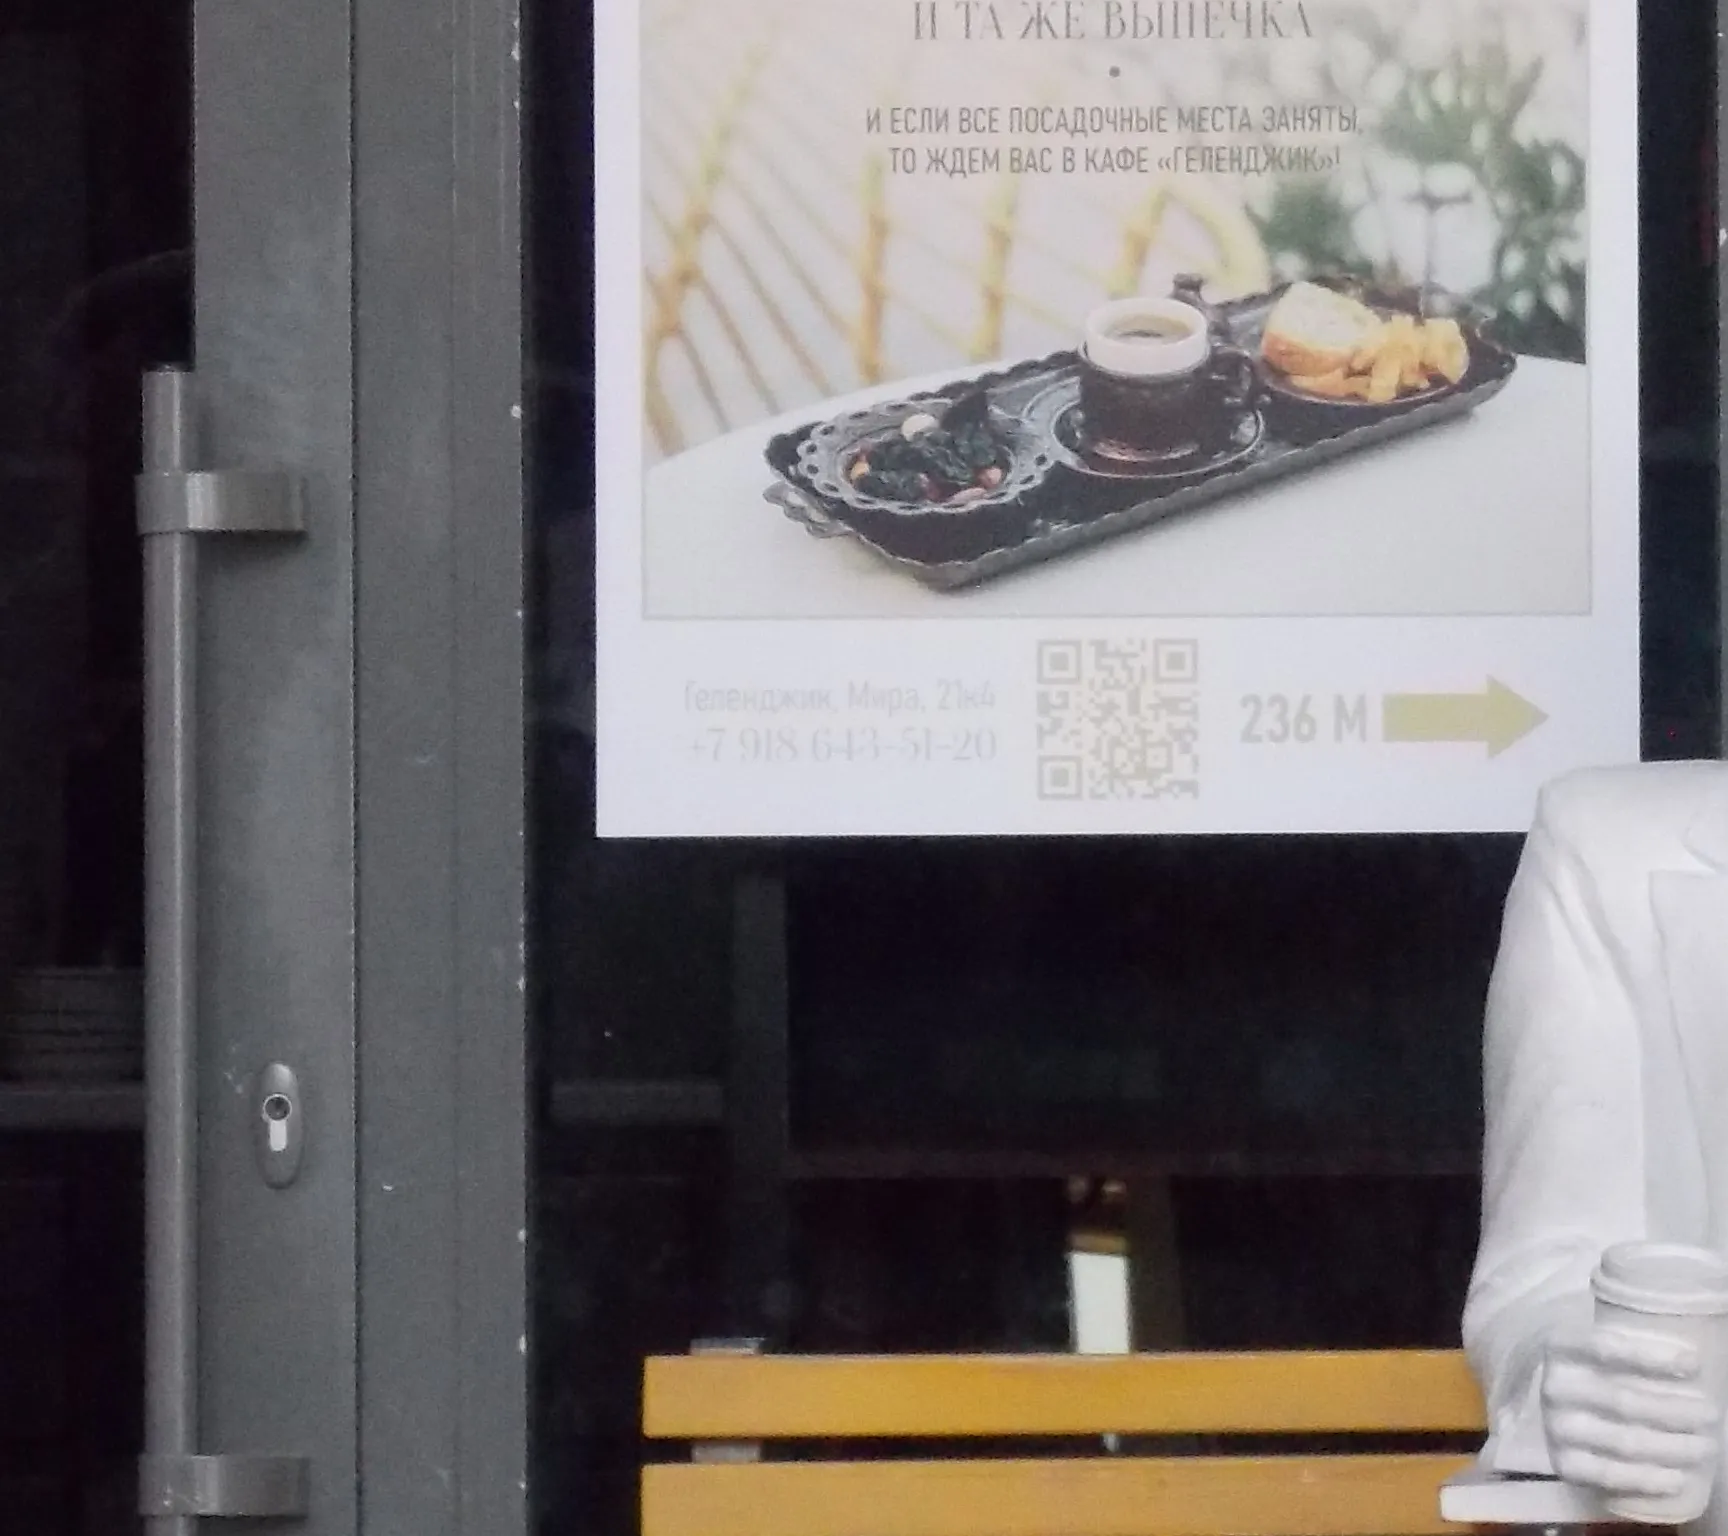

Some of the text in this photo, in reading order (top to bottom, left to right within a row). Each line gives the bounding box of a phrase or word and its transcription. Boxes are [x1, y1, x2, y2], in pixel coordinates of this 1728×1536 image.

[913, 0, 1312, 42] И ТА ЖЕ ВЫПЕЧКА
[866, 105, 1365, 137] И ЕСЛИ ВСЕ ПОСАДОЧНЫЕ МЕСТА ЗАНЯТЫ,
[890, 146, 1340, 178] ТО ЖДЕМ ВАС В КАФЕ «ГЕЛЕНДЖИК»!
[684, 678, 996, 716] Геленджик, Мира, 21к4
[1240, 692, 1366, 744] 236 М
[688, 725, 997, 763] +7 918 643-51-20
